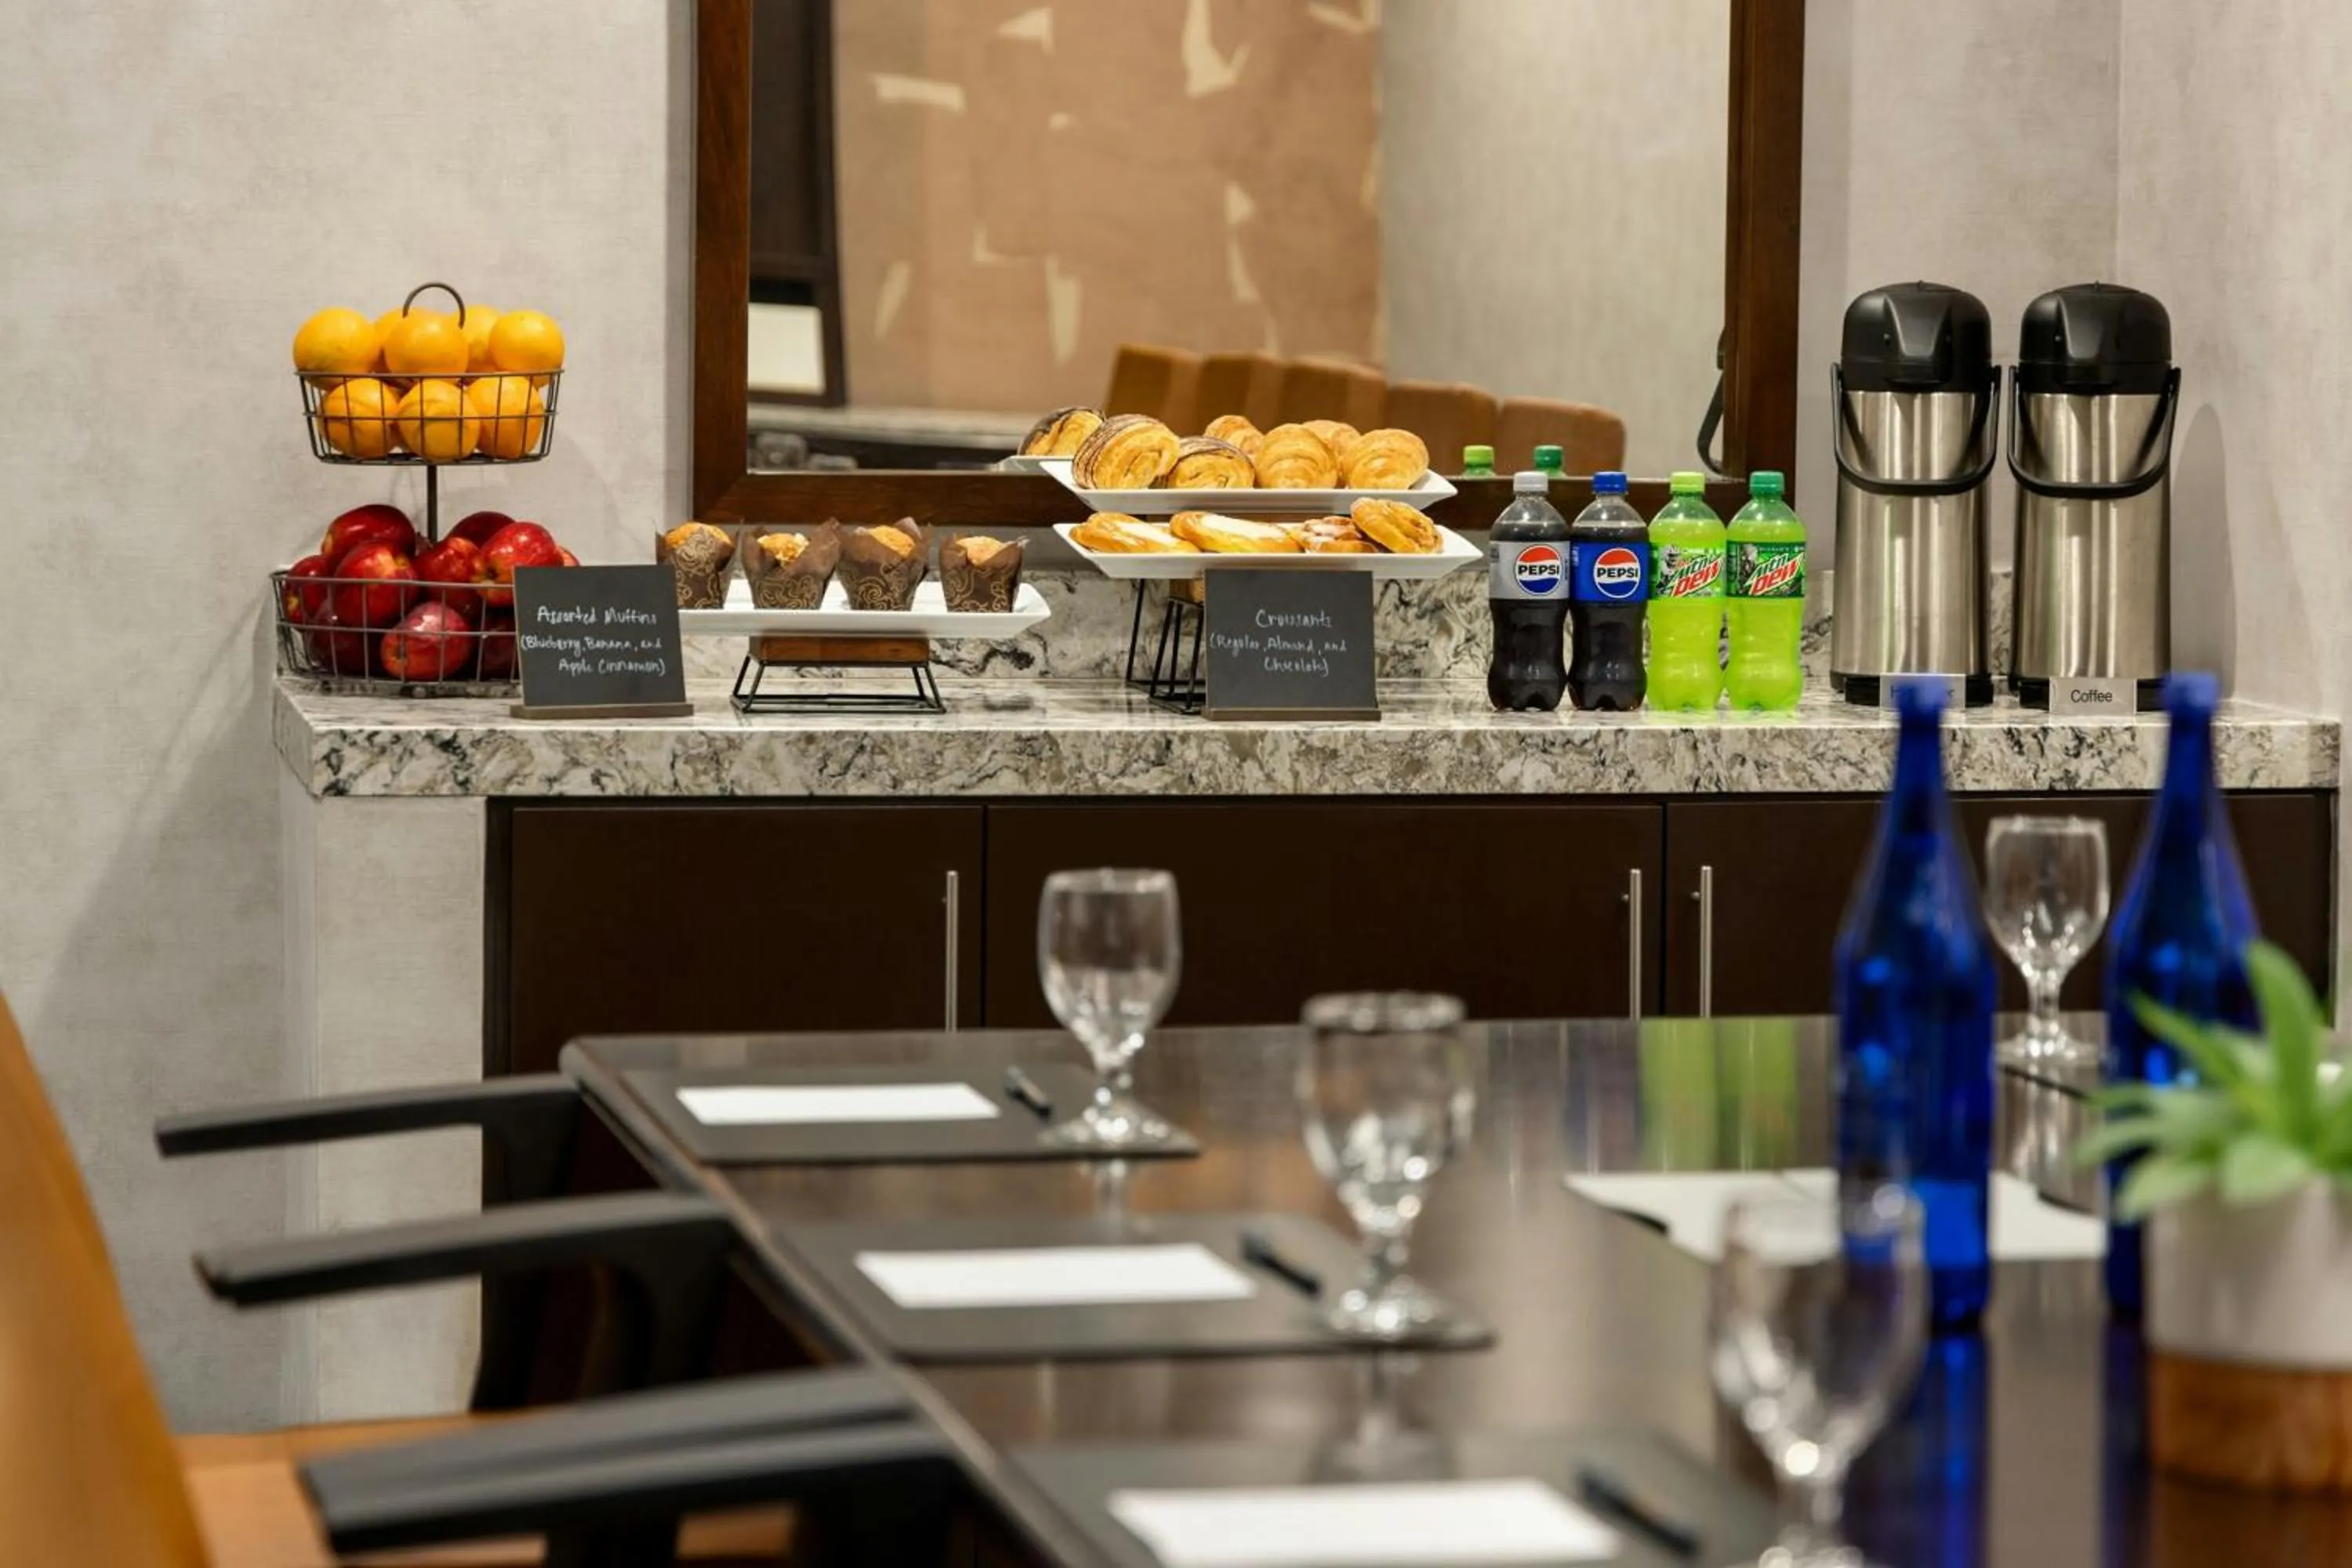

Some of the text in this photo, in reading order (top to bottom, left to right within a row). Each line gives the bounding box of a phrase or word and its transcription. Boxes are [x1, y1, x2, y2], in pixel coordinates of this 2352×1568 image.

[1517, 564, 1559, 575] PEPSI
[1596, 567, 1639, 578] PEPSI
[537, 605, 657, 625] Assorted Muffins
[1255, 608, 1333, 628] Croissants
[641, 637, 662, 648] and
[1324, 640, 1347, 652] and
[558, 658, 666, 677] Apple Cinnamon)
[2071, 689, 2113, 703] Coffee
